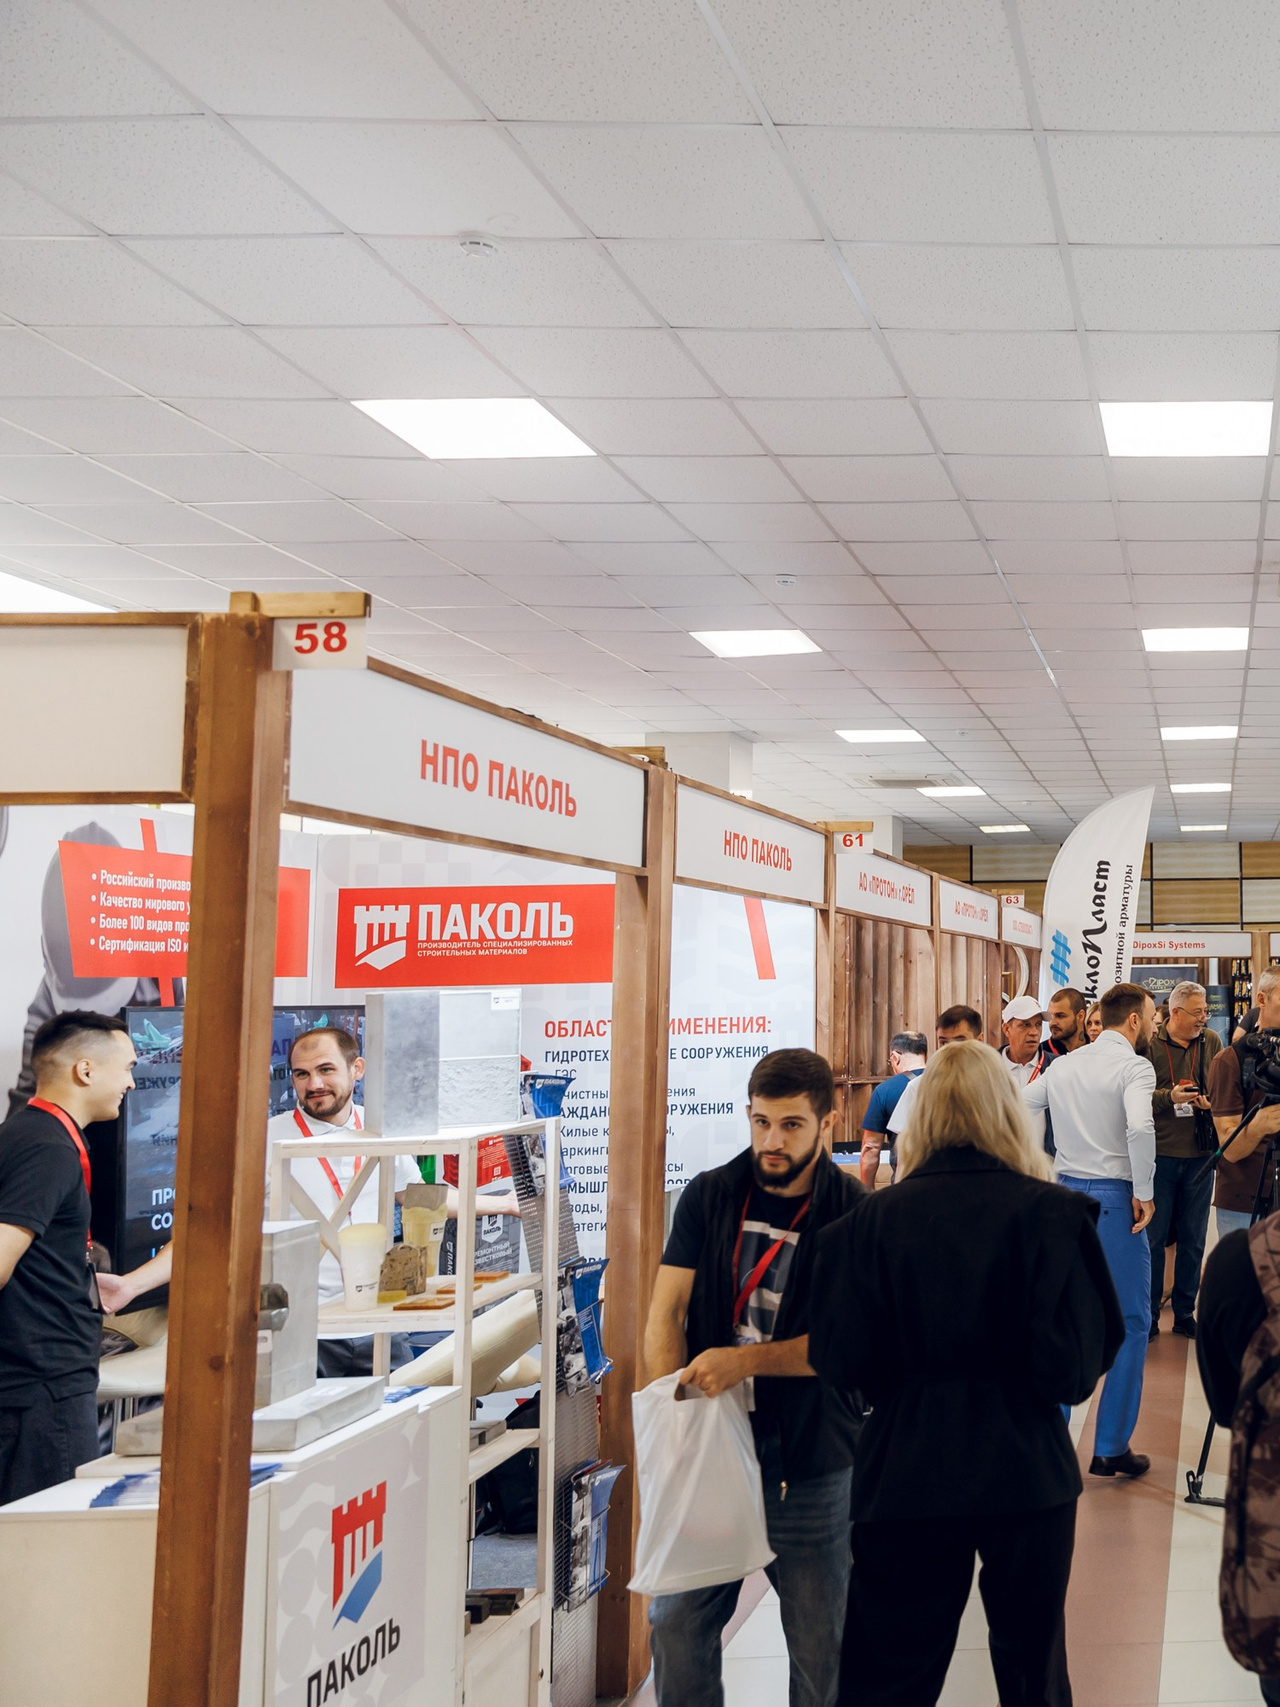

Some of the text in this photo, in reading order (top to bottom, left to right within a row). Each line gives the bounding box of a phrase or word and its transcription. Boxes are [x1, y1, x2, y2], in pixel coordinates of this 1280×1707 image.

[294, 621, 348, 654] 58
[420, 738, 577, 818] НПО ПАКОЛЬ
[842, 833, 864, 848] 61
[723, 830, 793, 872] НПО ПАКОЛЬ
[100, 870, 154, 888] Российский
[99, 891, 143, 909] Качество
[145, 899, 185, 913] мирового
[1005, 895, 1020, 905] 63
[1119, 864, 1133, 928] арматуры
[99, 913, 128, 930] Более
[129, 915, 144, 930] 100
[146, 919, 173, 933] видов
[418, 902, 574, 941] ПАКОЛЬ
[98, 936, 165, 954] Сертификация
[167, 938, 182, 953] ISO
[417, 939, 573, 949] ПРОИЗВОДИТЕЛЬ СПЕЦИАЛИЗИРОВАННЫХ
[417, 948, 528, 957] СТРОИТЕЛЬНЫХ МАТЕРИАЛОВ
[1133, 941, 1206, 950] DipoxSi Systems
[681, 1045, 769, 1060] СООРУЖЕНИЯ
[307, 1617, 401, 1707] ПАКОЛЬ
